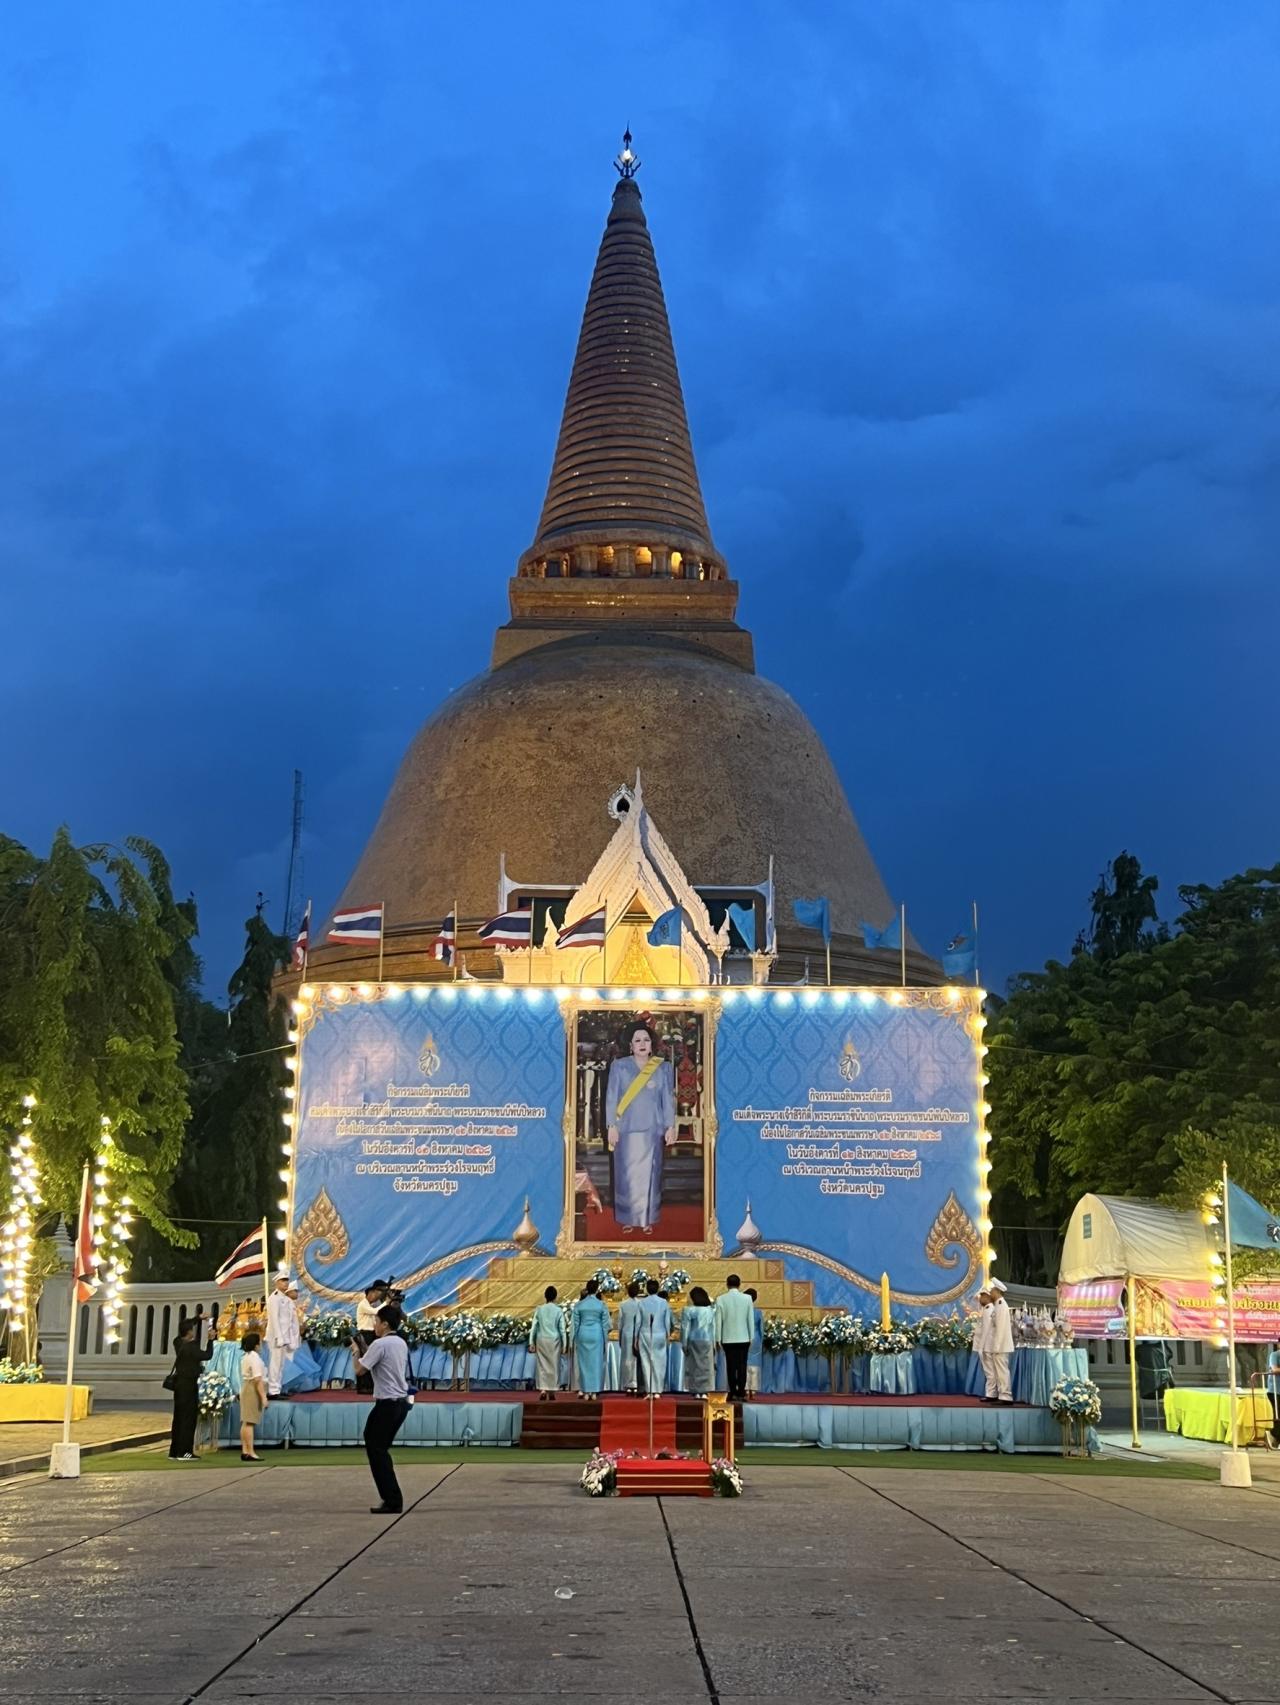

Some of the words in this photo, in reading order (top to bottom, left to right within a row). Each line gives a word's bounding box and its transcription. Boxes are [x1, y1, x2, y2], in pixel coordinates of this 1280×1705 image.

[387, 1083, 470, 1097] กิจกรรมเฉลิมพระเกียรติ
[809, 1088, 892, 1102] กิจกรรมเฉลิมพระเกียรติ
[733, 1104, 812, 1120] สมเด็จพระนางเจ้าสิริกิติ์
[813, 1108, 875, 1122] พระบรมราชินีนาถ
[876, 1108, 969, 1122] พระบรมราชชนนีพันปีหลวง
[467, 1121, 495, 1135] สิงหาคม
[760, 1121, 878, 1139] เนื่องในโอกาสวันเฉลิมพระชนมพรรษา
[890, 1126, 918, 1140] สิงหาคม
[362, 1138, 415, 1155] ในวันอังคารที่
[431, 1141, 464, 1155] สิงหาคม
[787, 1142, 840, 1159] ในวันอังคารที่
[841, 1149, 855, 1159] ๑๒
[856, 1145, 889, 1159] สิงหาคม
[890, 1149, 917, 1160] ๒๕๖๘
[356, 1163, 366, 1174] ณ
[368, 1156, 495, 1176] บริเวณลานหน้าพระร่วงโรจนฤทธิ์
[782, 1164, 792, 1175] ณ
[793, 1161, 921, 1180] บริเวณลานหน้าพระร่วงโรจนฤทธิ์
[393, 1177, 458, 1196] จังหวัดนครปฐม
[820, 1179, 884, 1198] จังหวัดนครปฐม
